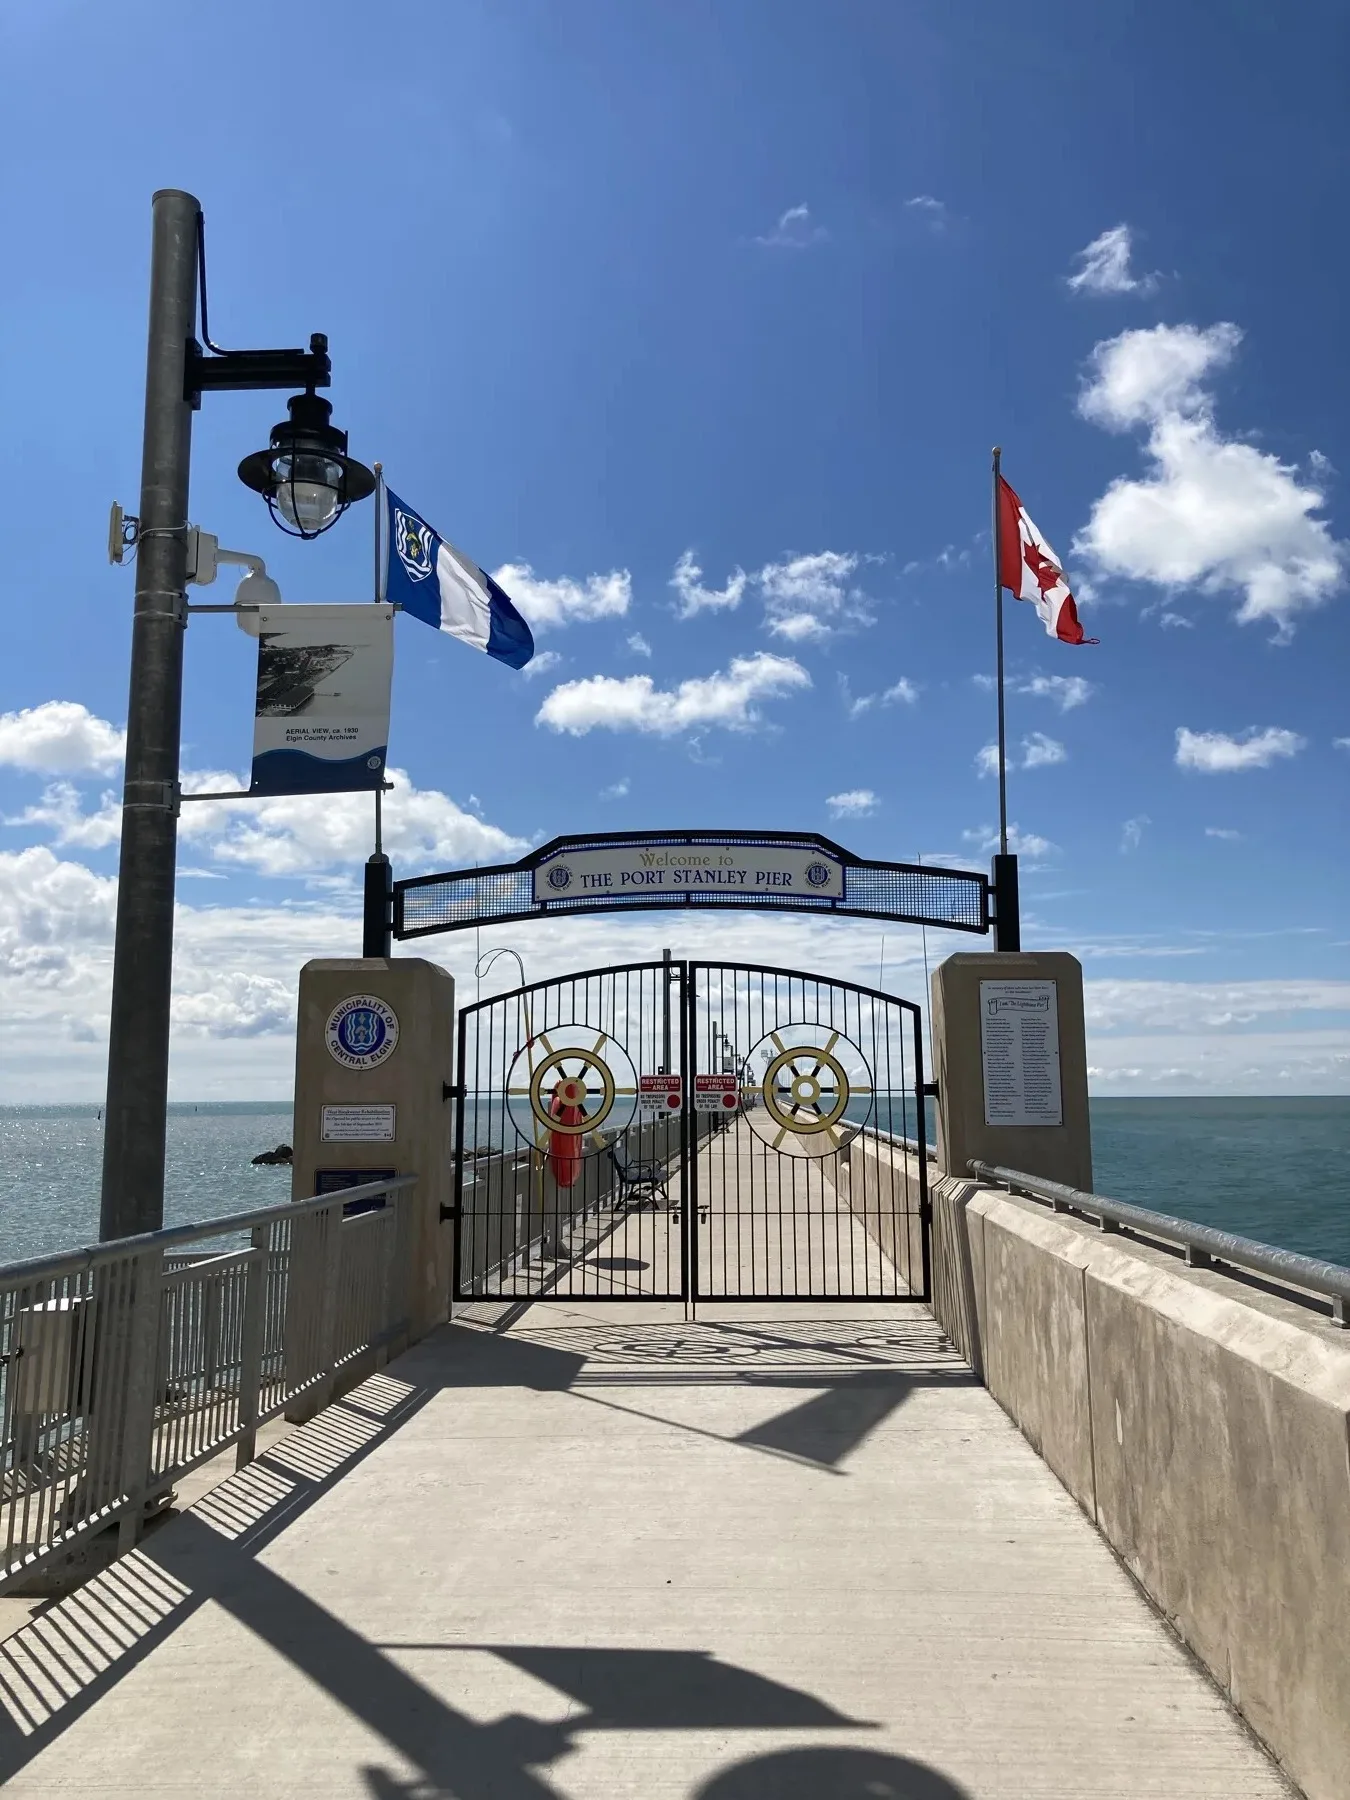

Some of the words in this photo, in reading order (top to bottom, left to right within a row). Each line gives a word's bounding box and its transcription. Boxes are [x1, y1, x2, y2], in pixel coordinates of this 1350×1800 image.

[639, 852, 711, 867] Welcome
[718, 852, 734, 867] to
[580, 872, 614, 888] THE
[620, 870, 667, 886] PORT
[673, 869, 748, 885] STANLEY
[755, 871, 793, 887] PIER
[330, 999, 388, 1031] MUNICIPALITY
[385, 1016, 395, 1030] OF
[330, 1040, 368, 1065] CENTRAL
[370, 1038, 393, 1062] ELGIN
